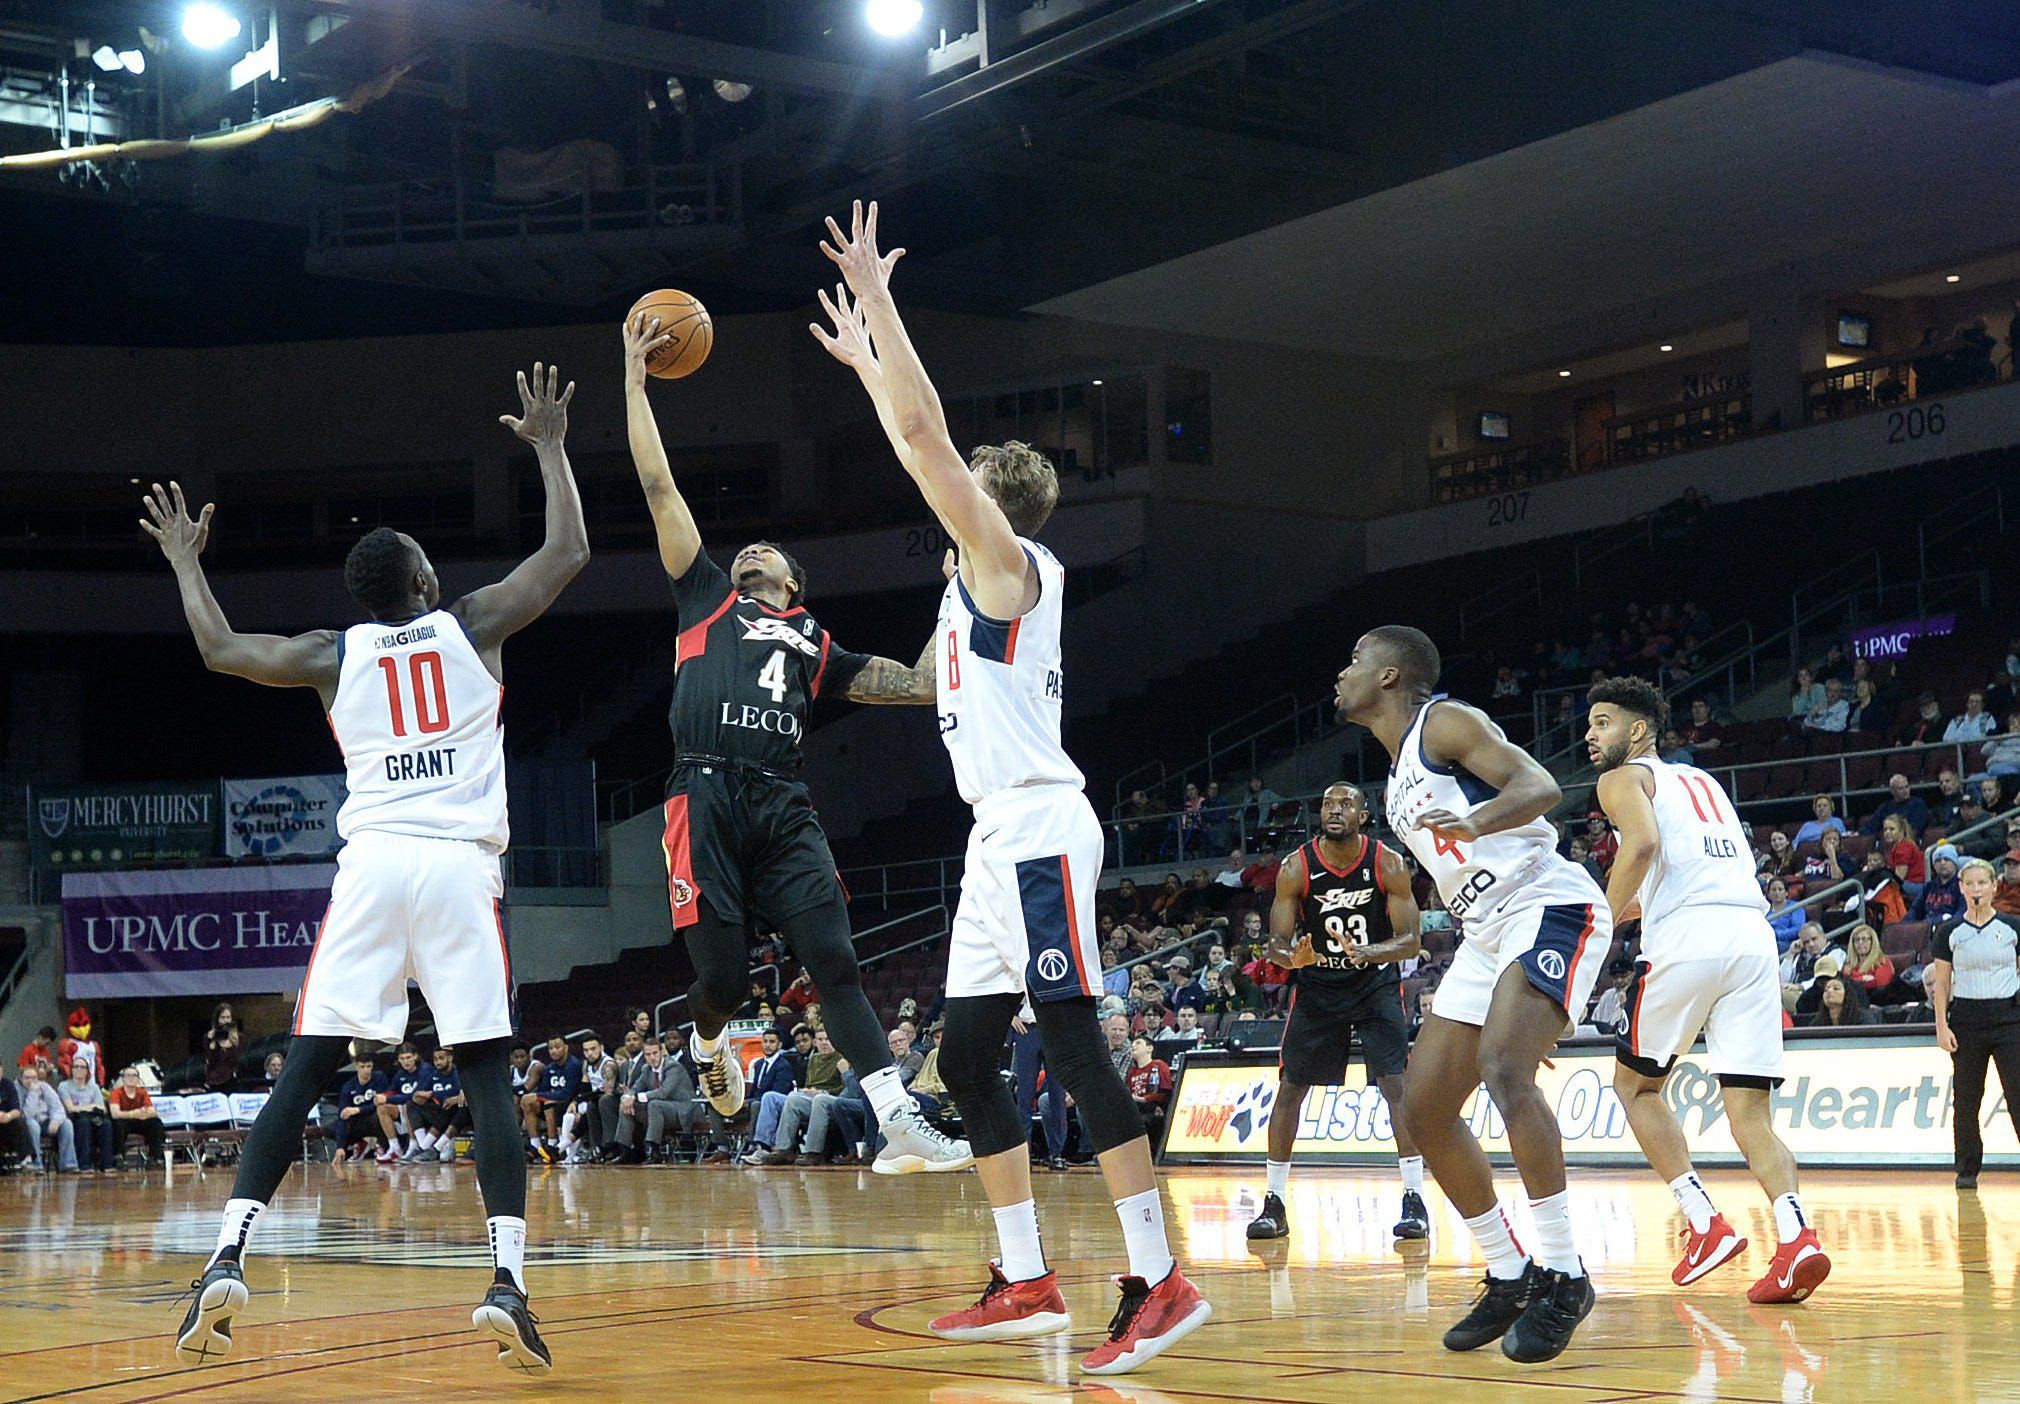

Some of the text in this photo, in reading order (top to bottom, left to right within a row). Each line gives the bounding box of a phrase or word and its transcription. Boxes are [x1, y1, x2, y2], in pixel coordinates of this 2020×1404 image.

[1888, 403, 1946, 444] 206
[1488, 491, 1530, 527] 207
[408, 625, 438, 643] LEAGUE
[1854, 632, 1911, 659] UPMC
[377, 650, 450, 737] 10
[757, 649, 787, 703] 4
[385, 747, 457, 782] GRANT
[73, 794, 213, 827] MERCYHURST
[1677, 774, 1724, 825] 11
[232, 817, 326, 836] Solutions
[1433, 832, 1466, 865] 4
[1313, 887, 1375, 914] ERIE
[1449, 868, 1497, 917] EICO
[83, 903, 221, 954] UPMC
[1185, 1104, 1235, 1143] Wolf
[1296, 1084, 1395, 1142] Liste
[1556, 1069, 1627, 1141] On
